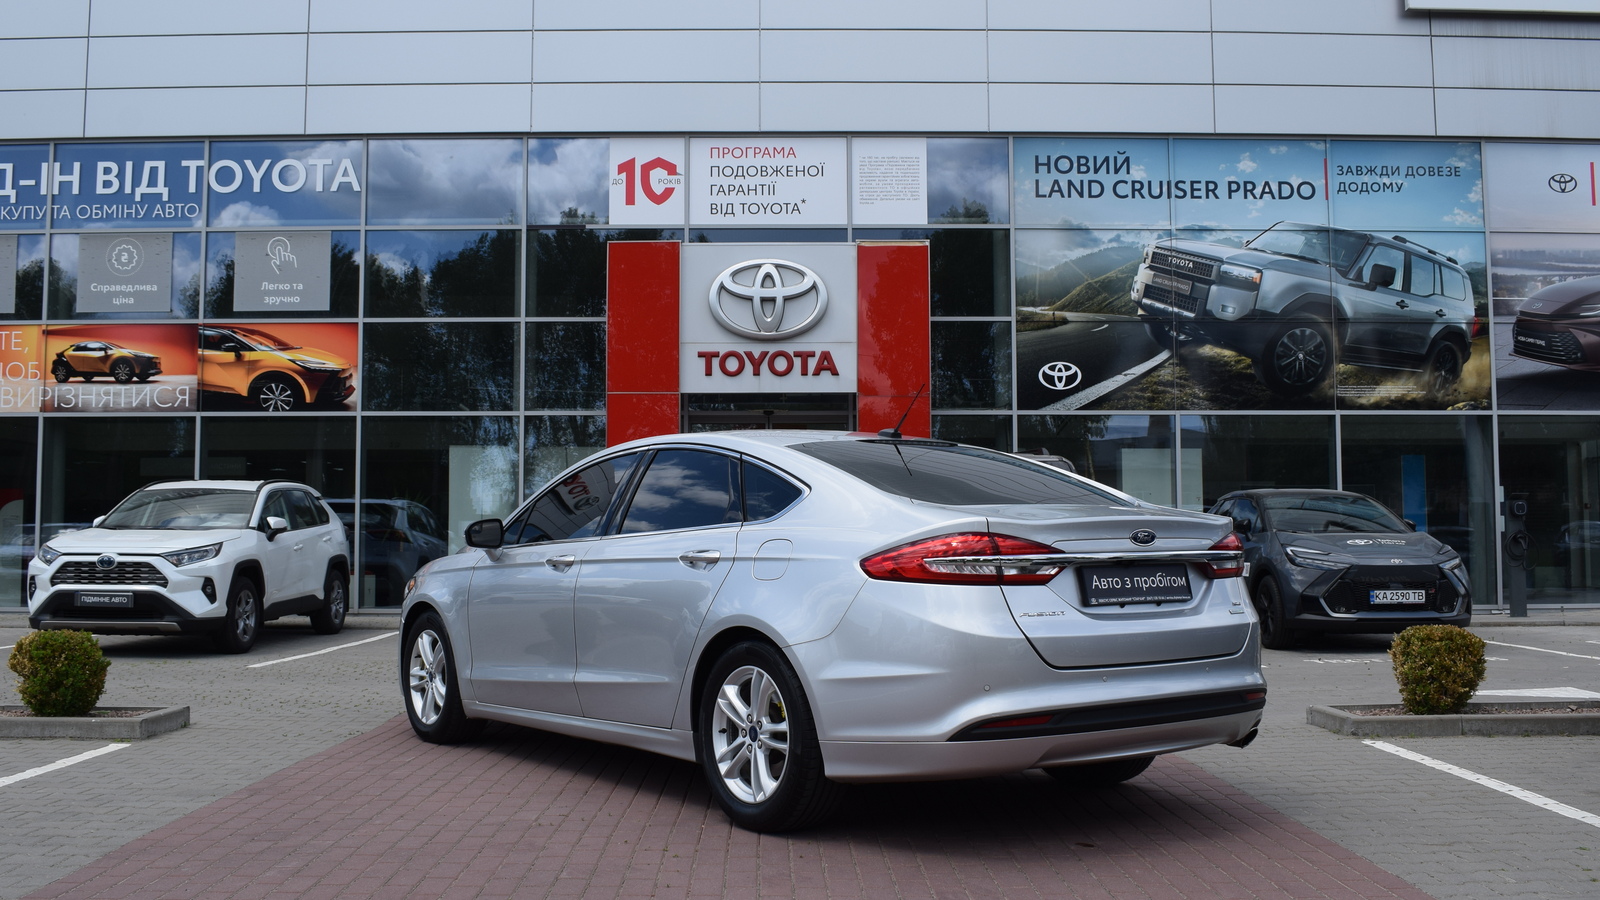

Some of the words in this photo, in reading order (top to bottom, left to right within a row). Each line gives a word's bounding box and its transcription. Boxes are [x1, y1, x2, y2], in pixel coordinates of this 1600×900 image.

[710, 146, 797, 159] ПРОГРАМА
[1034, 150, 1131, 175] НОВИЙ
[710, 162, 825, 180] ПОДОВЖЕНОЇ
[1336, 164, 1400, 178] ЗАВЖДИ
[1404, 165, 1461, 179] ДОВЕЗЕ
[95, 160, 169, 202] ВІД
[181, 158, 361, 194] TOYOTA
[611, 178, 624, 186] ДО
[710, 180, 777, 196] ГАРАНТІЇ
[1034, 178, 1105, 199] LAND
[1112, 179, 1220, 200] CRUISER
[1227, 180, 1316, 200] PRADO
[1336, 181, 1404, 195] ДОДОМУ
[0, 205, 47, 220] КУПУ
[51, 204, 71, 219] ТА
[76, 203, 149, 219] ОБМІНУ
[152, 202, 200, 218] АВТО
[710, 202, 736, 217] ВІД
[1168, 257, 1193, 268] TOYOTA
[90, 283, 158, 294] Справедлива
[260, 281, 291, 291] Легко
[112, 295, 135, 305] ціна
[263, 296, 301, 305] зручно
[697, 350, 840, 377] TOYOTA
[0, 361, 41, 385] ОБ
[0, 385, 190, 409] ВИРІЗНЯТИСЯ
[1092, 575, 1121, 589] Авто
[1124, 577, 1132, 588] з
[1134, 572, 1187, 591] пробігом
[1389, 592, 1410, 600] 2590
